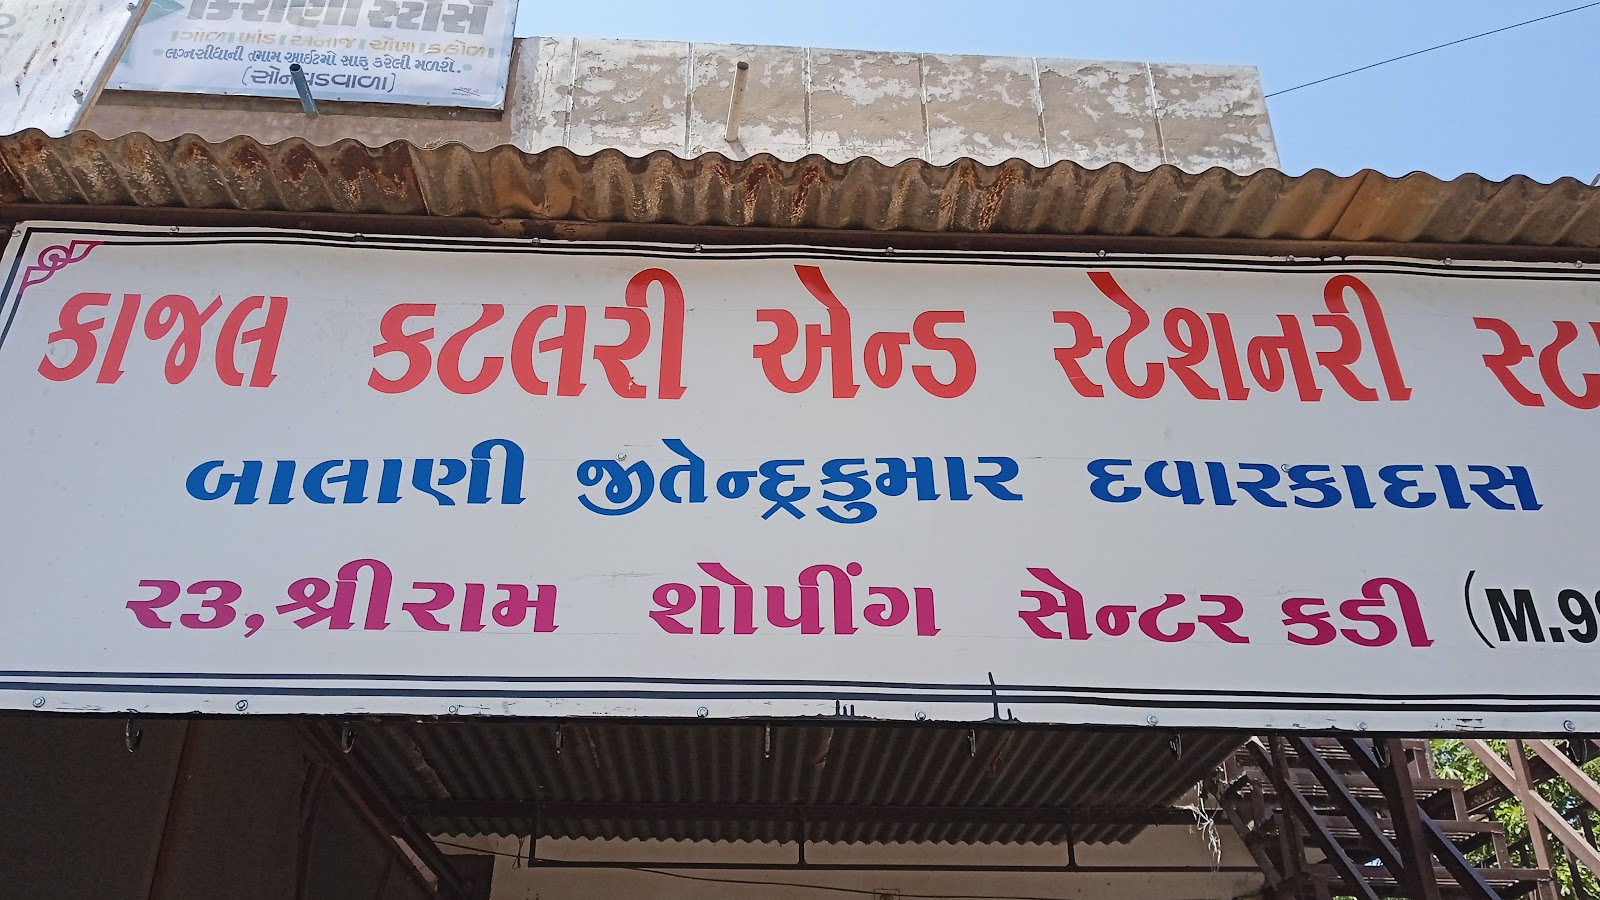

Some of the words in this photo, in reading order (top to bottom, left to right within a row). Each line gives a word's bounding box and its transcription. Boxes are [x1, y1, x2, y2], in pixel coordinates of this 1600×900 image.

[247, 50, 282, 63] તમામ
[340, 54, 369, 71] સાફ
[372, 54, 411, 71] કરેલી
[37, 292, 288, 388] કાજલ
[367, 268, 688, 400] કટલરી
[753, 264, 978, 399] એન્ડ
[1053, 271, 1413, 402] સ્ટેશનરી
[1473, 316, 1600, 410] સ્ટ
[185, 438, 526, 506] બાલાણી
[576, 438, 1024, 524] જીતેન્દ્રકુમાર
[1086, 458, 1544, 511] દવારકાદાસ
[648, 561, 942, 637] શોપીંગ
[1018, 567, 1250, 645] સેન્ટર
[1281, 576, 1435, 648] કડી
[1464, 570, 1600, 649] (M.9
